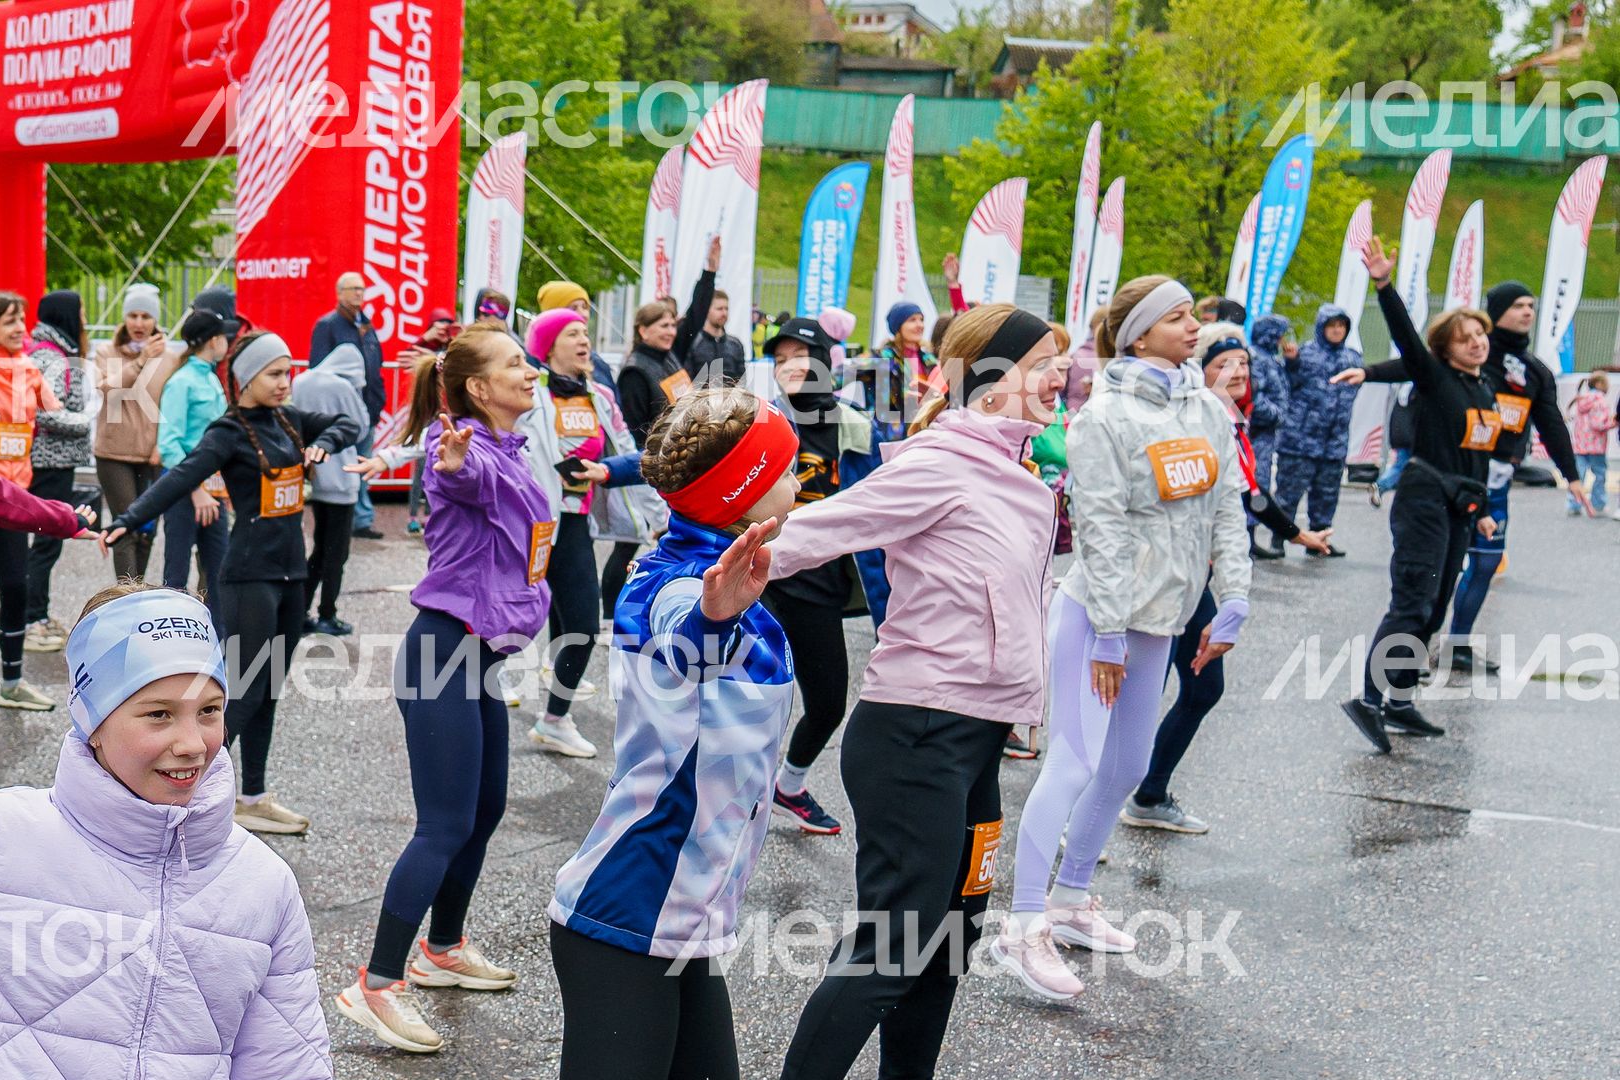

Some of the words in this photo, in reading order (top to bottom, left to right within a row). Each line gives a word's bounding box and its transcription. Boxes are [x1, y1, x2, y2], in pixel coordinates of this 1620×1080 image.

[3, 36, 132, 87] ПОЛУМАРАФОН
[362, 2, 405, 342] СУПЕРЛИГА
[397, 3, 433, 343] ПОДМОСКОВЬЯ
[1164, 457, 1209, 489] 5004
[138, 617, 210, 635] OZERY
[151, 630, 172, 642] SKI
[175, 630, 210, 643] TEAM
